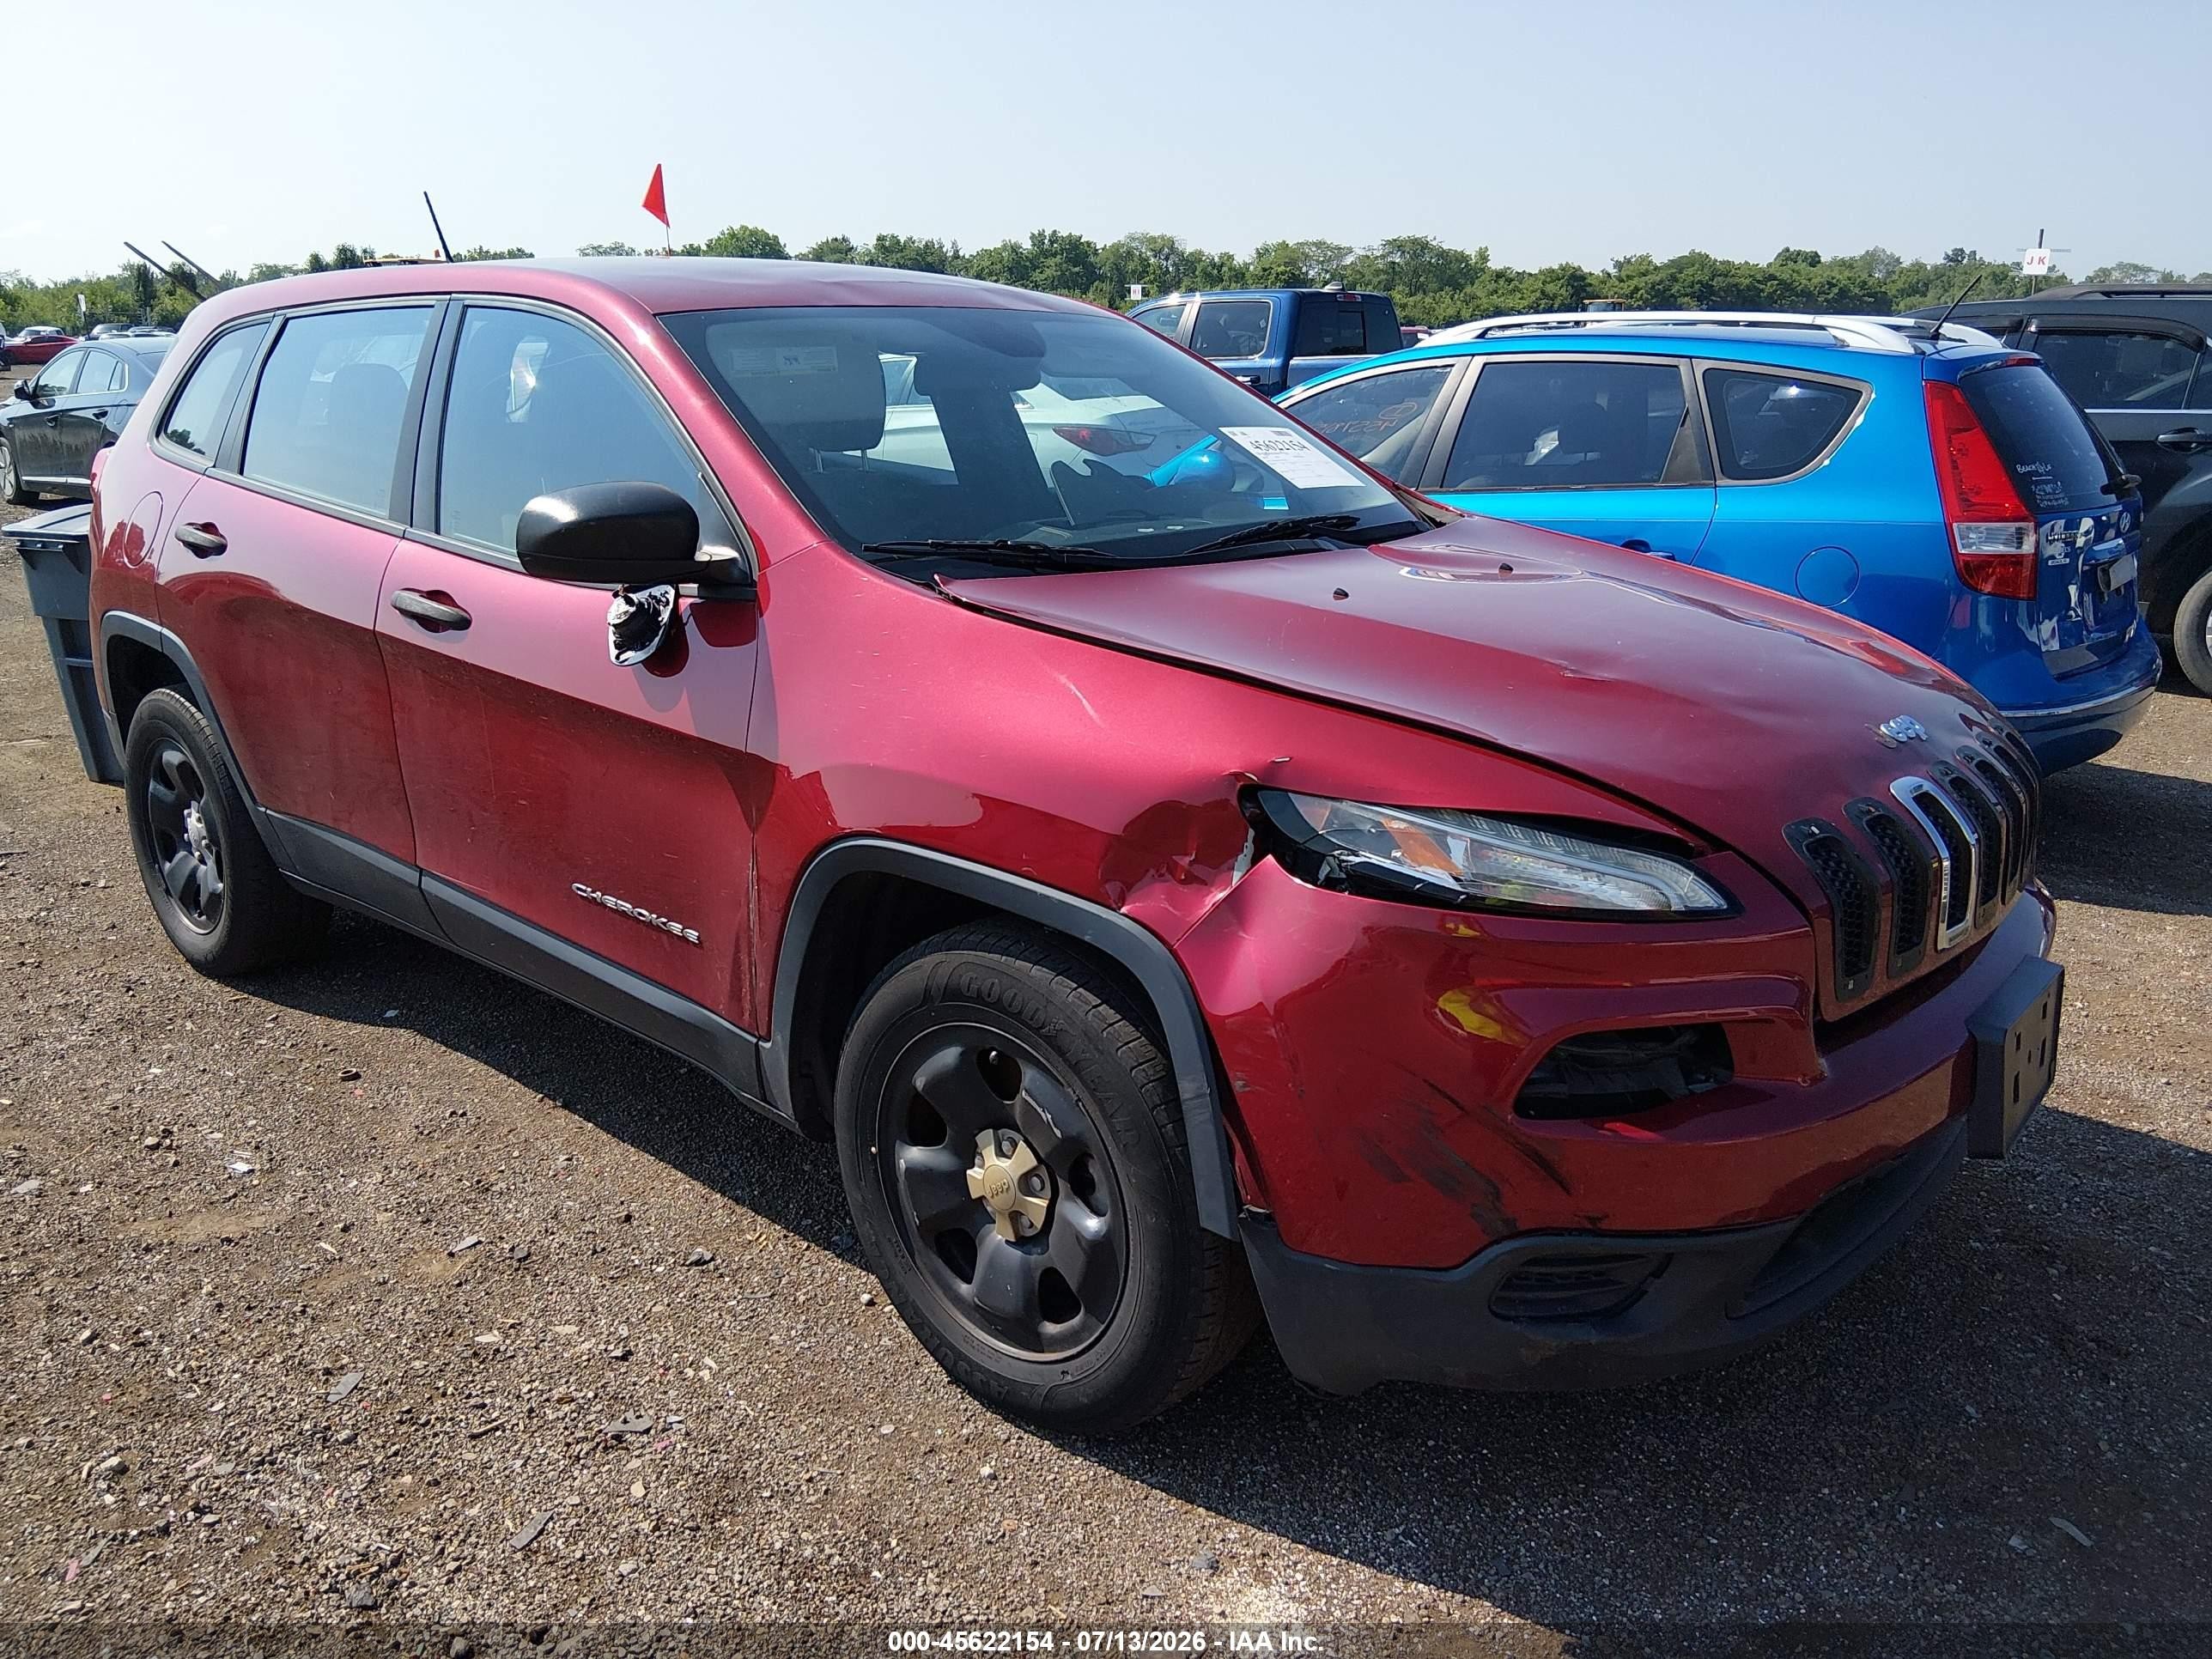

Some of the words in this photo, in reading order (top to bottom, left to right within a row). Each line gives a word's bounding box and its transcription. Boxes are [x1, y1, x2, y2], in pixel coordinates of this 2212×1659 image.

[1249, 439, 1311, 452] 45622154
[571, 883, 700, 945] CHEROKEE
[987, 1177, 1012, 1200] Jeep
